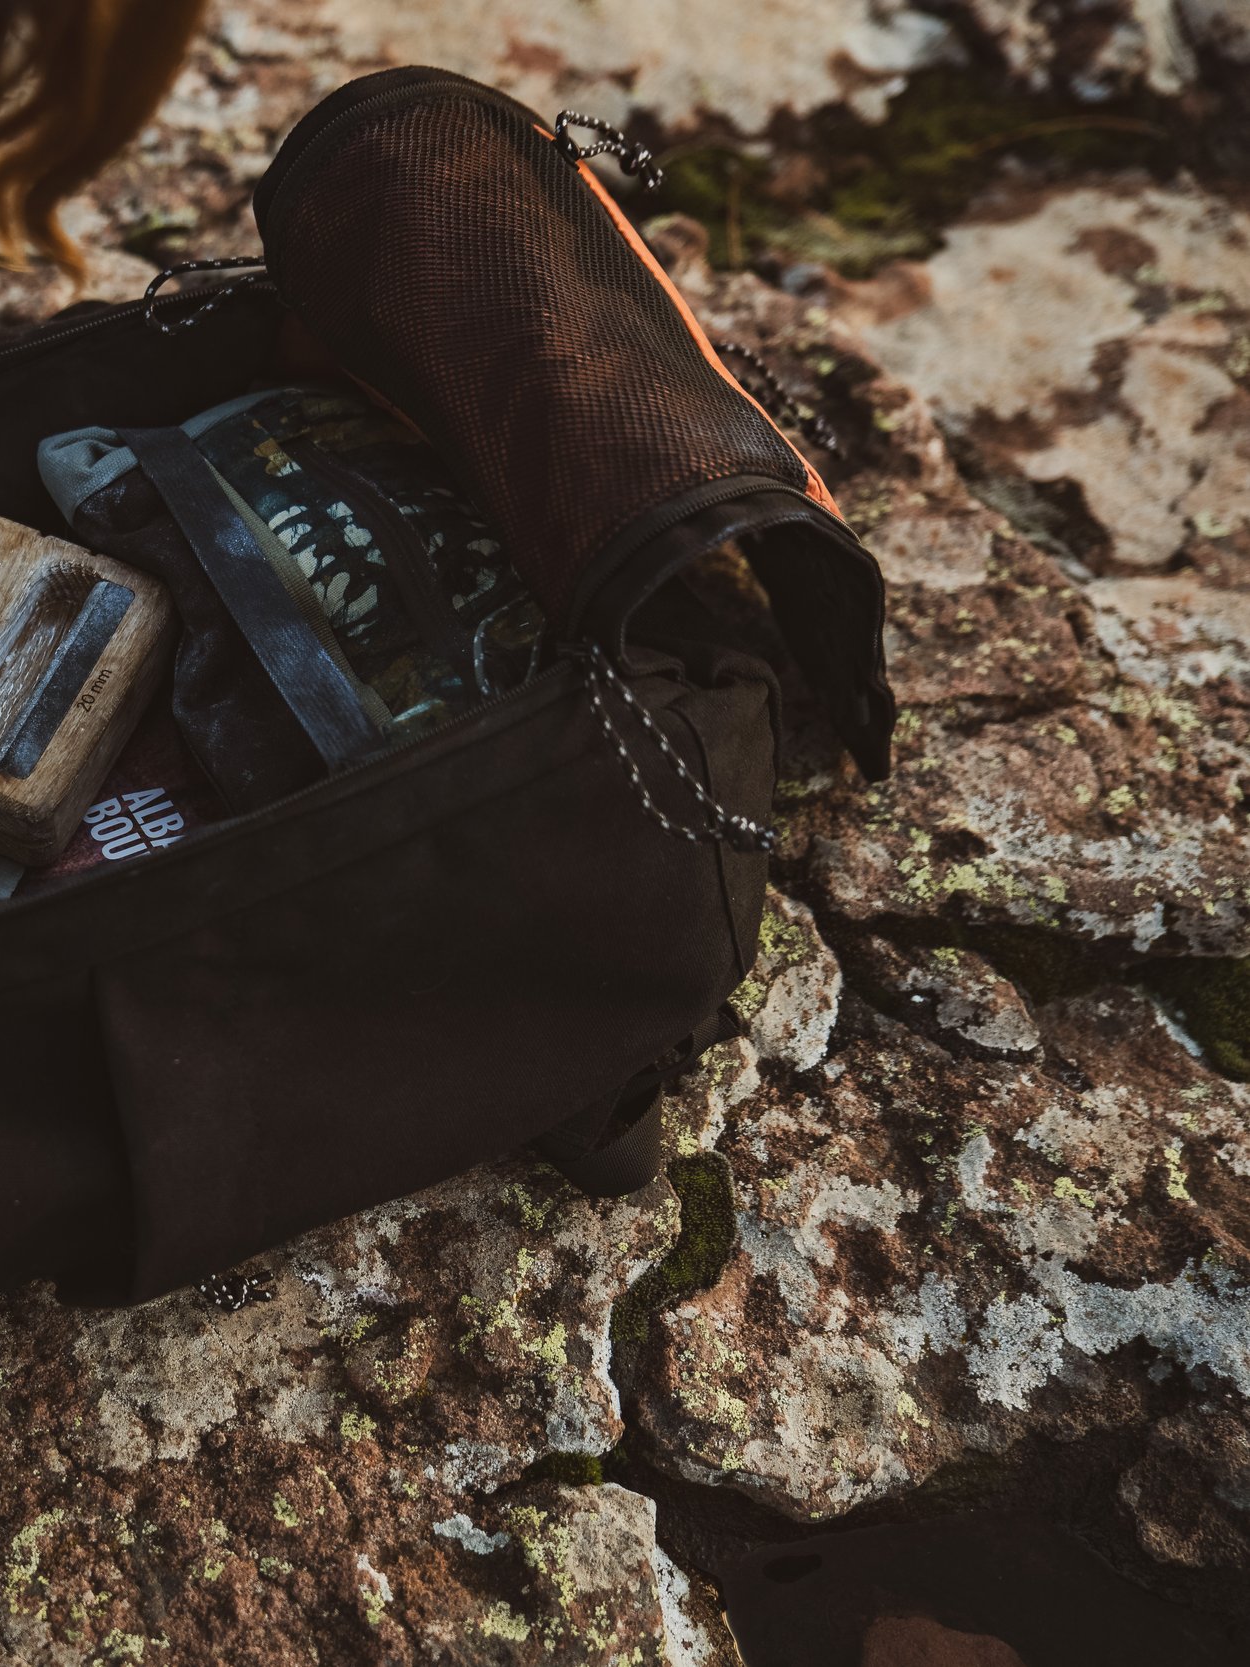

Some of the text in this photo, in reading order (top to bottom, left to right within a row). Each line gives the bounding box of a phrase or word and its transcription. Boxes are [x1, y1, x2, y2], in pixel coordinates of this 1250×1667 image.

[76, 669, 113, 713] 20 mm
[83, 797, 151, 860] BOU
